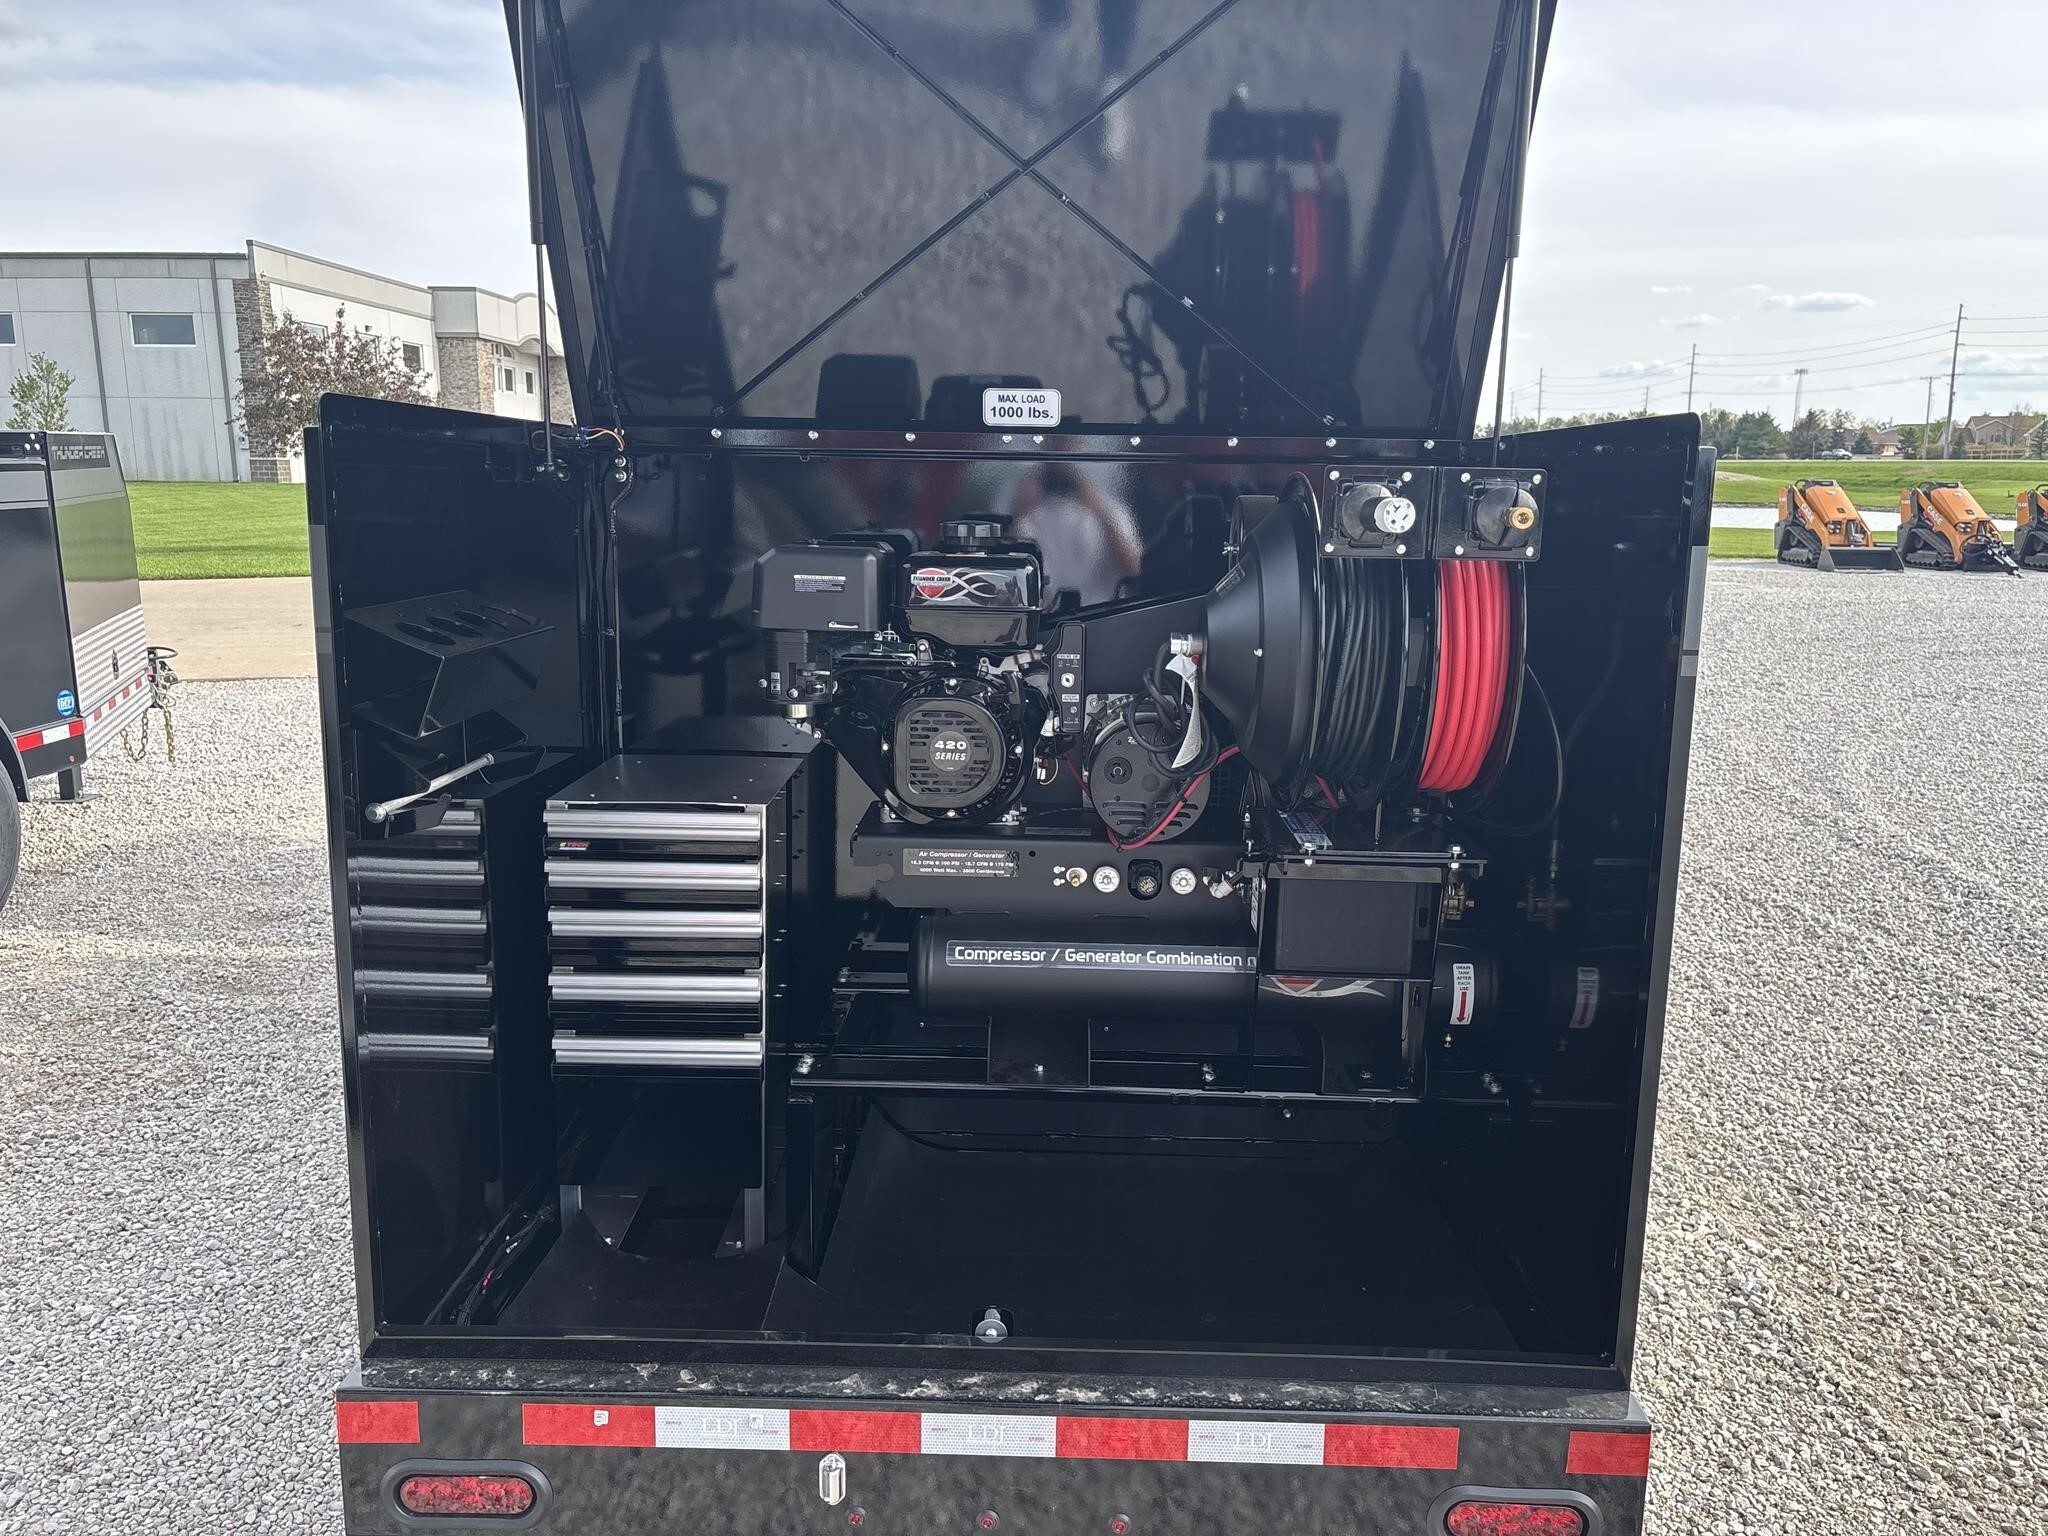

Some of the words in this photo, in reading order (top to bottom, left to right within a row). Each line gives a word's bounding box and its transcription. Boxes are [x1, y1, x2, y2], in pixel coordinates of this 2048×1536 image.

[998, 394, 1019, 403] MAX.
[1021, 395, 1046, 404] LOAD
[990, 406, 1023, 418] 1000
[1028, 407, 1054, 419] lbs.
[1927, 505, 1943, 526] CASE
[934, 740, 967, 750] 420
[934, 752, 967, 761] SERIES
[929, 851, 968, 859] Compressor
[954, 946, 1047, 963] Compressor
[1050, 948, 1060, 961] /
[1065, 949, 1142, 962] Generator
[1146, 950, 1242, 966] Combination
